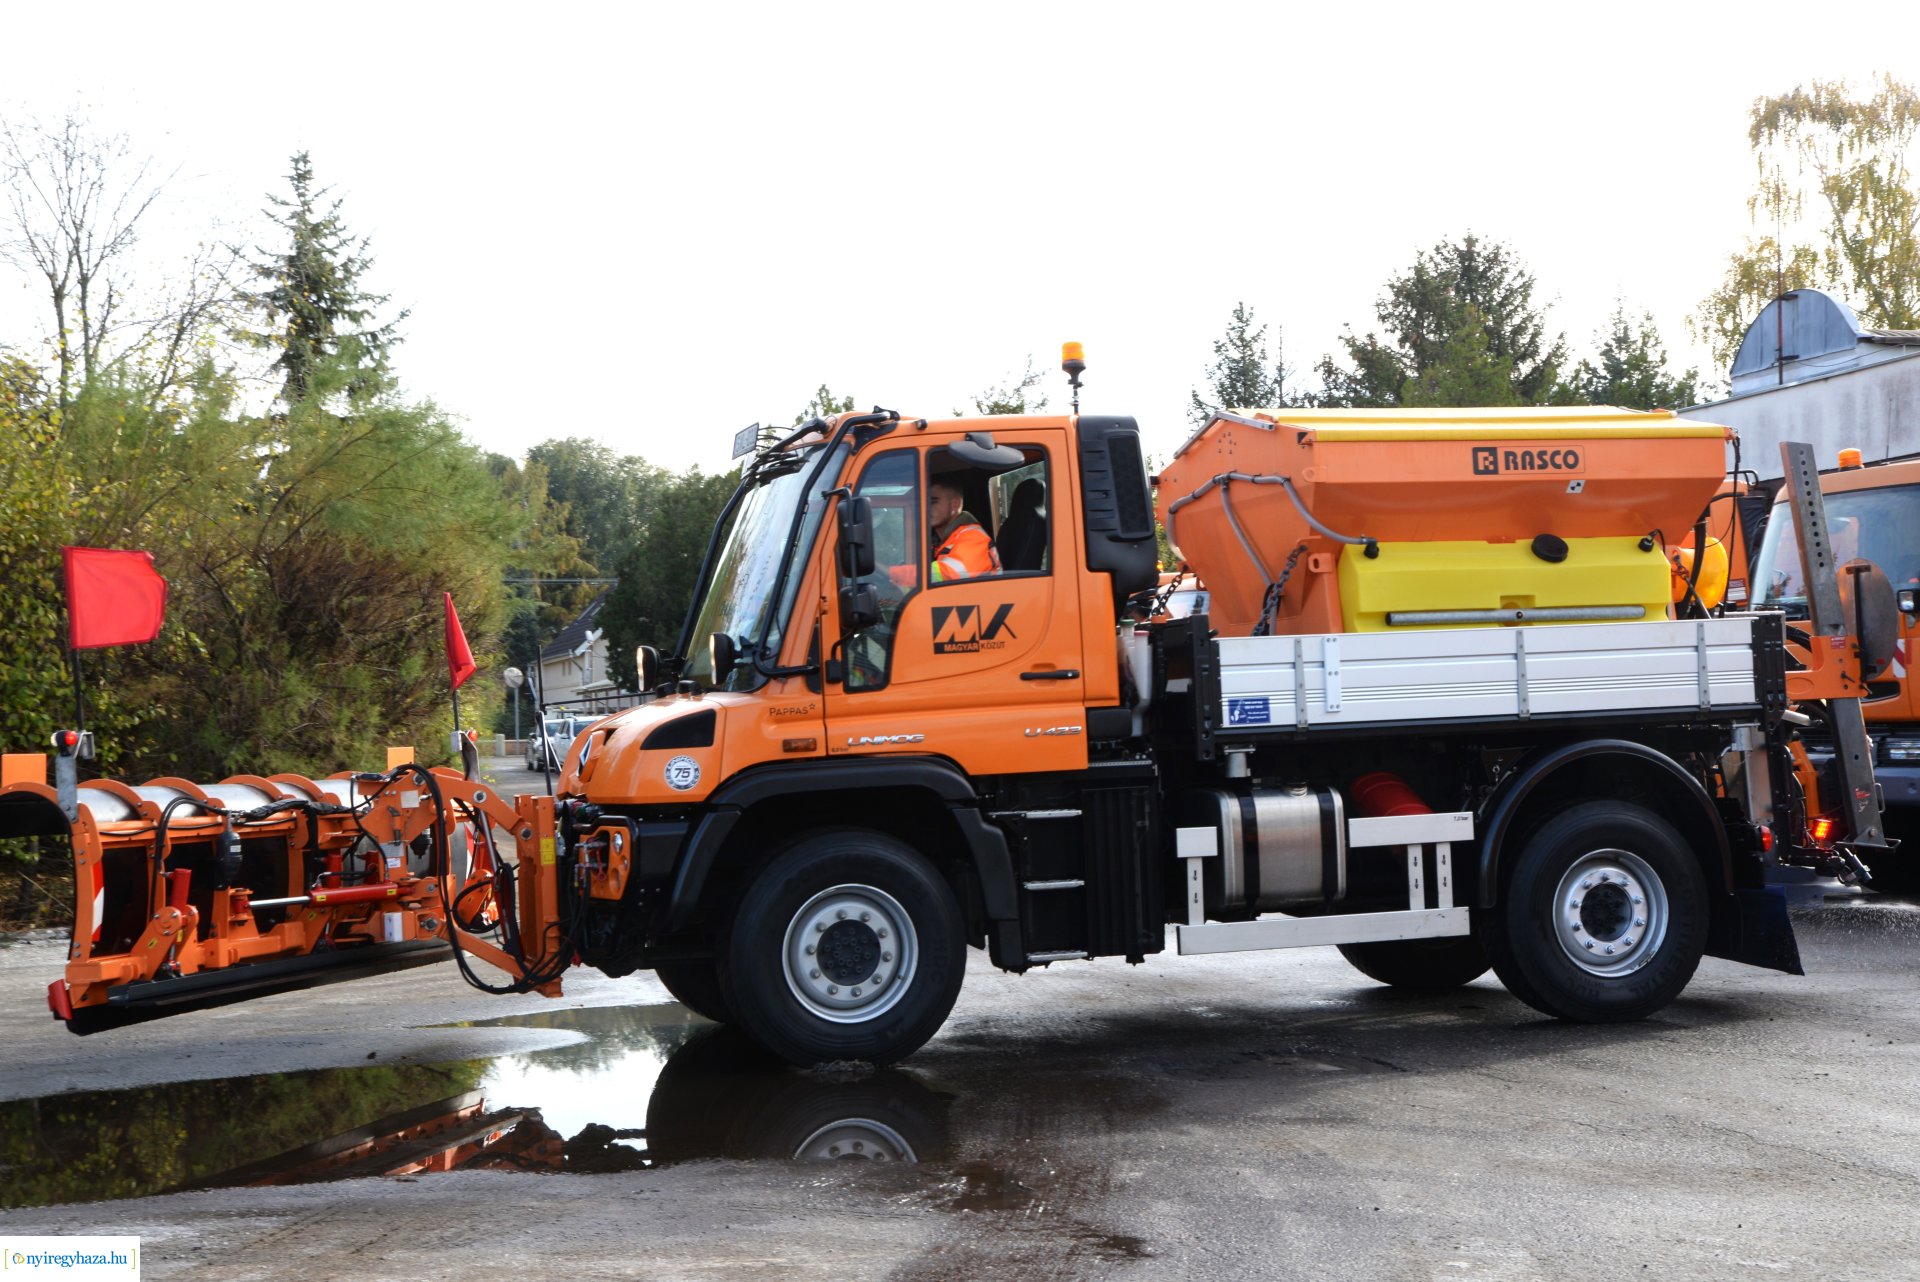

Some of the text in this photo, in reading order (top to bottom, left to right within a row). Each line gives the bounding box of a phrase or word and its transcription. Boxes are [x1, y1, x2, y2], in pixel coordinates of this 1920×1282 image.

[1504, 450, 1580, 471] RASCO
[943, 642, 979, 653] MAGYAR
[769, 705, 809, 717] PAPPAS
[847, 733, 925, 747] UNIMOG
[674, 767, 692, 779] 75
